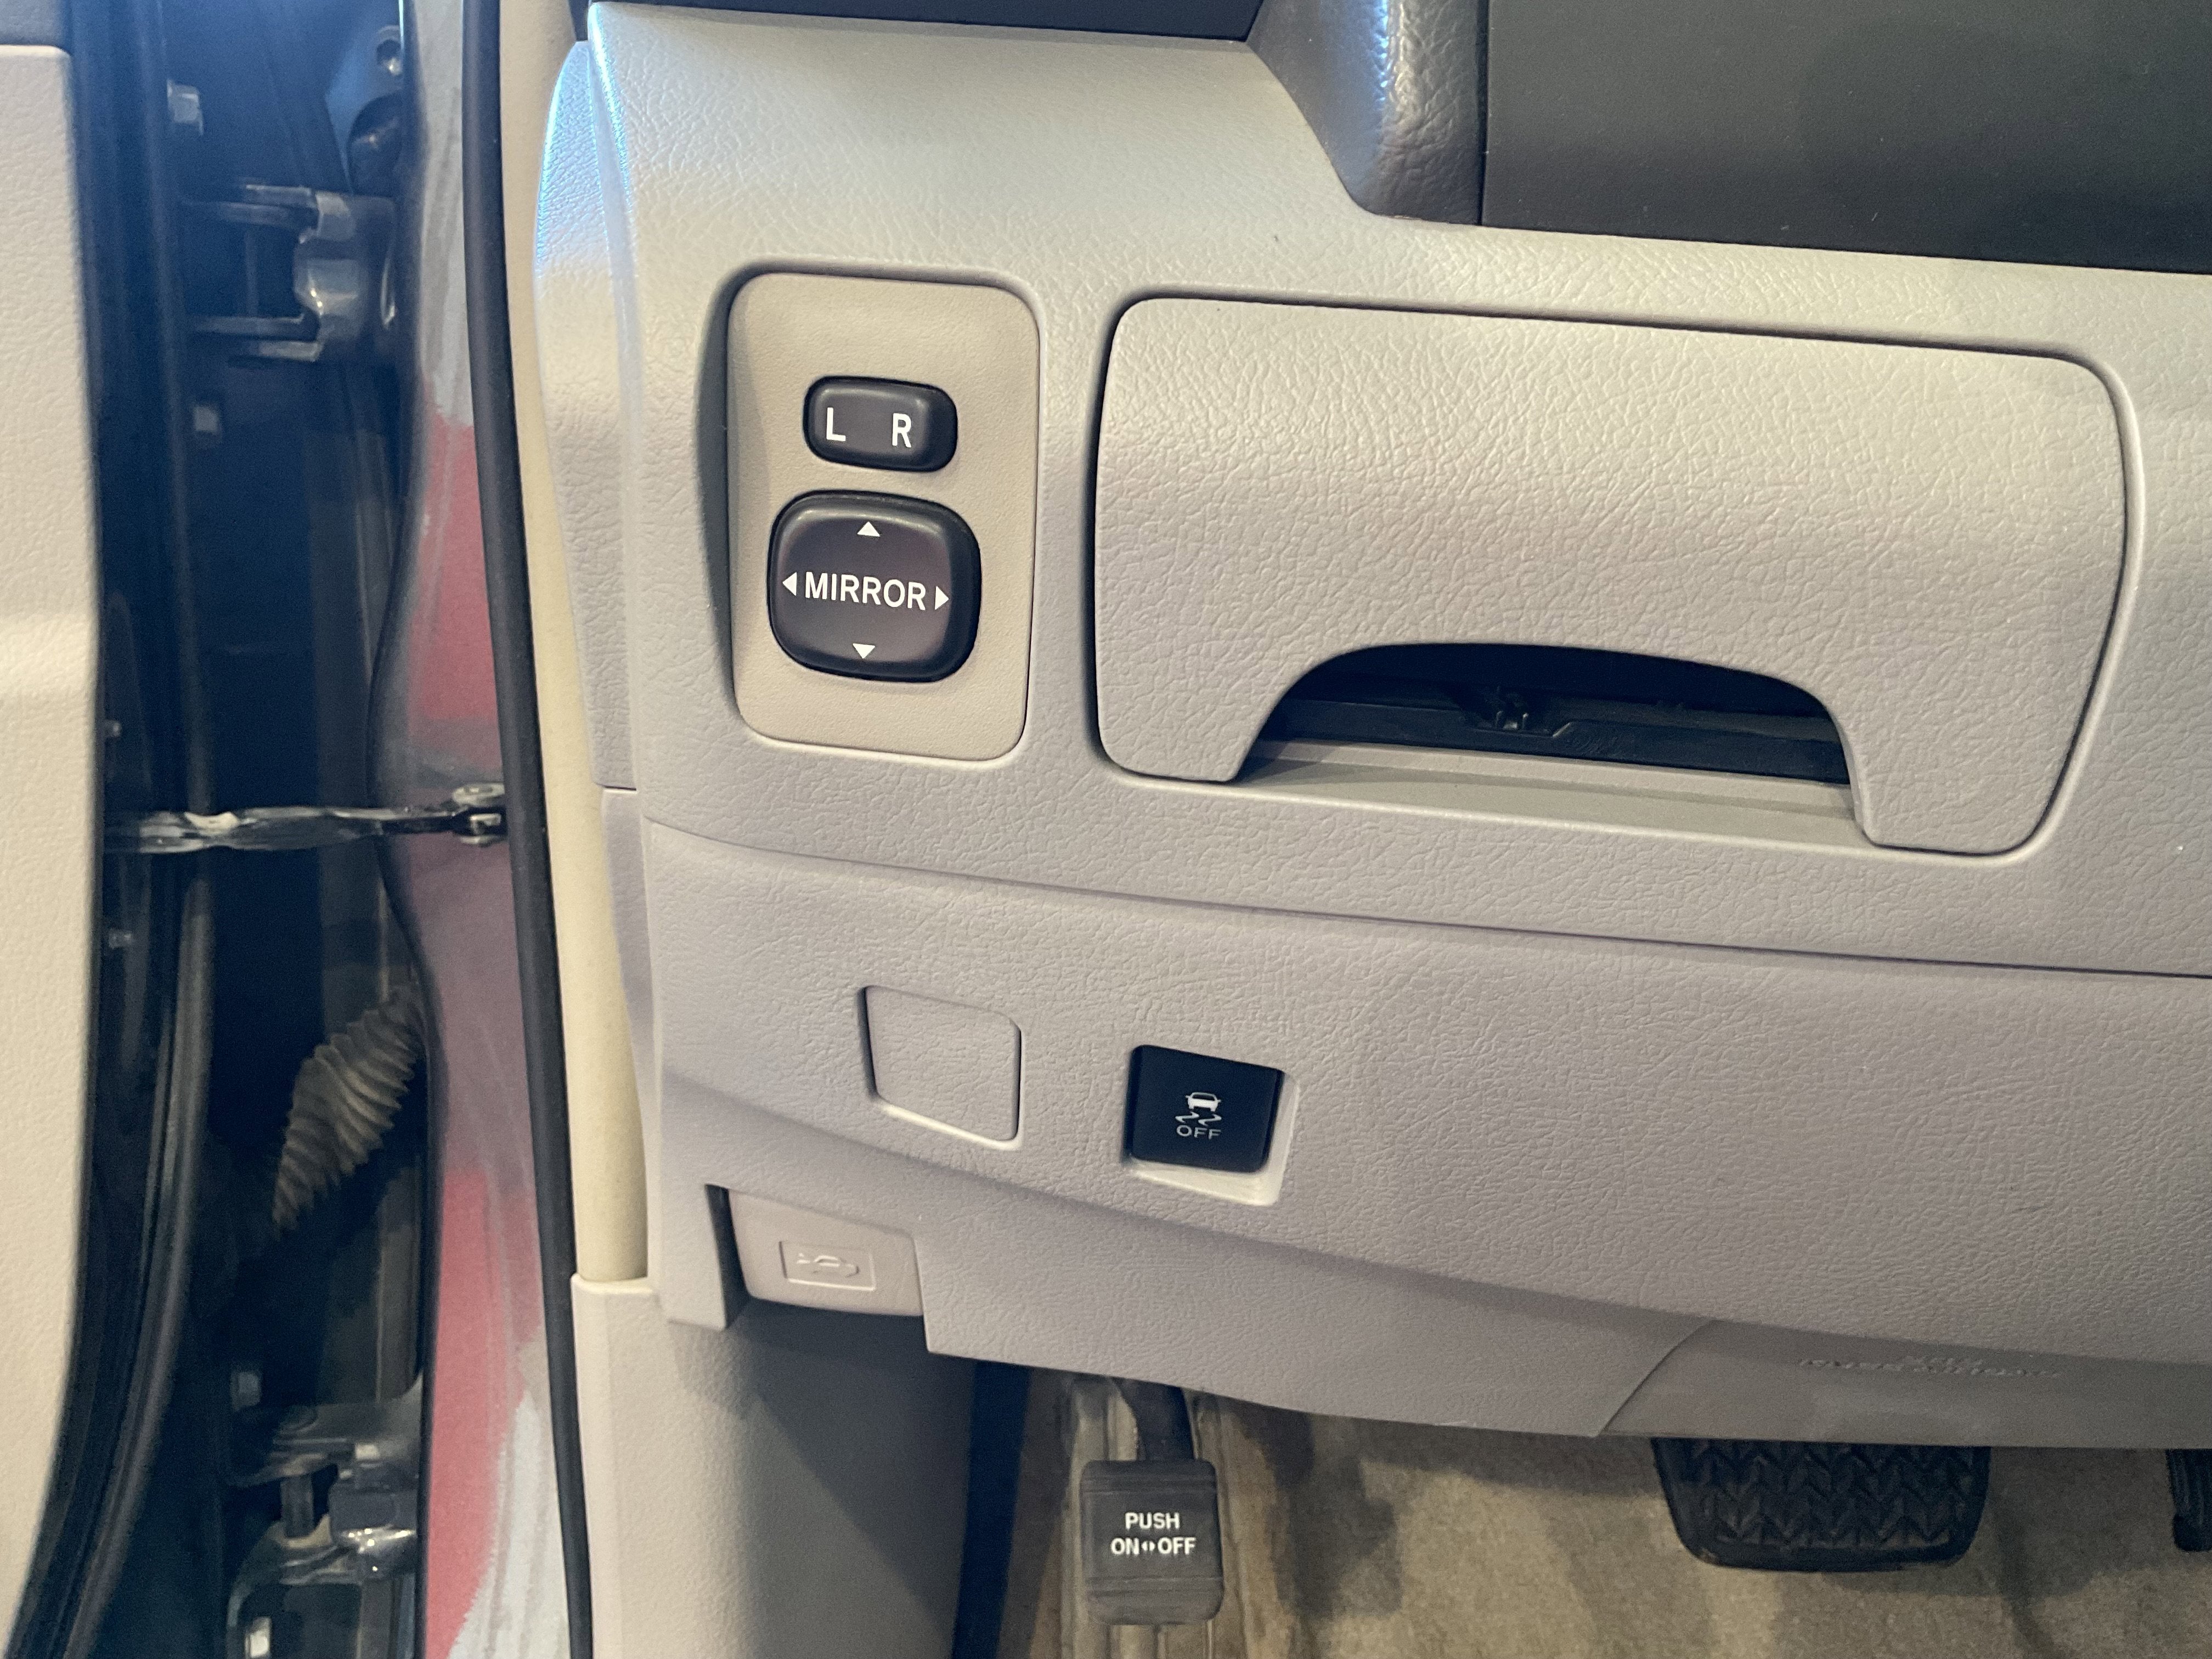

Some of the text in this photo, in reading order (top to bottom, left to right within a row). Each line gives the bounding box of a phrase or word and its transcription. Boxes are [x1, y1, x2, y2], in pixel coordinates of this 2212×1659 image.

[826, 407, 912, 448] L R
[804, 571, 927, 611] MIRROR
[1176, 1125, 1222, 1140] OFF
[1125, 1511, 1181, 1530] PUSH
[1110, 1536, 1197, 1556] ON OFF
